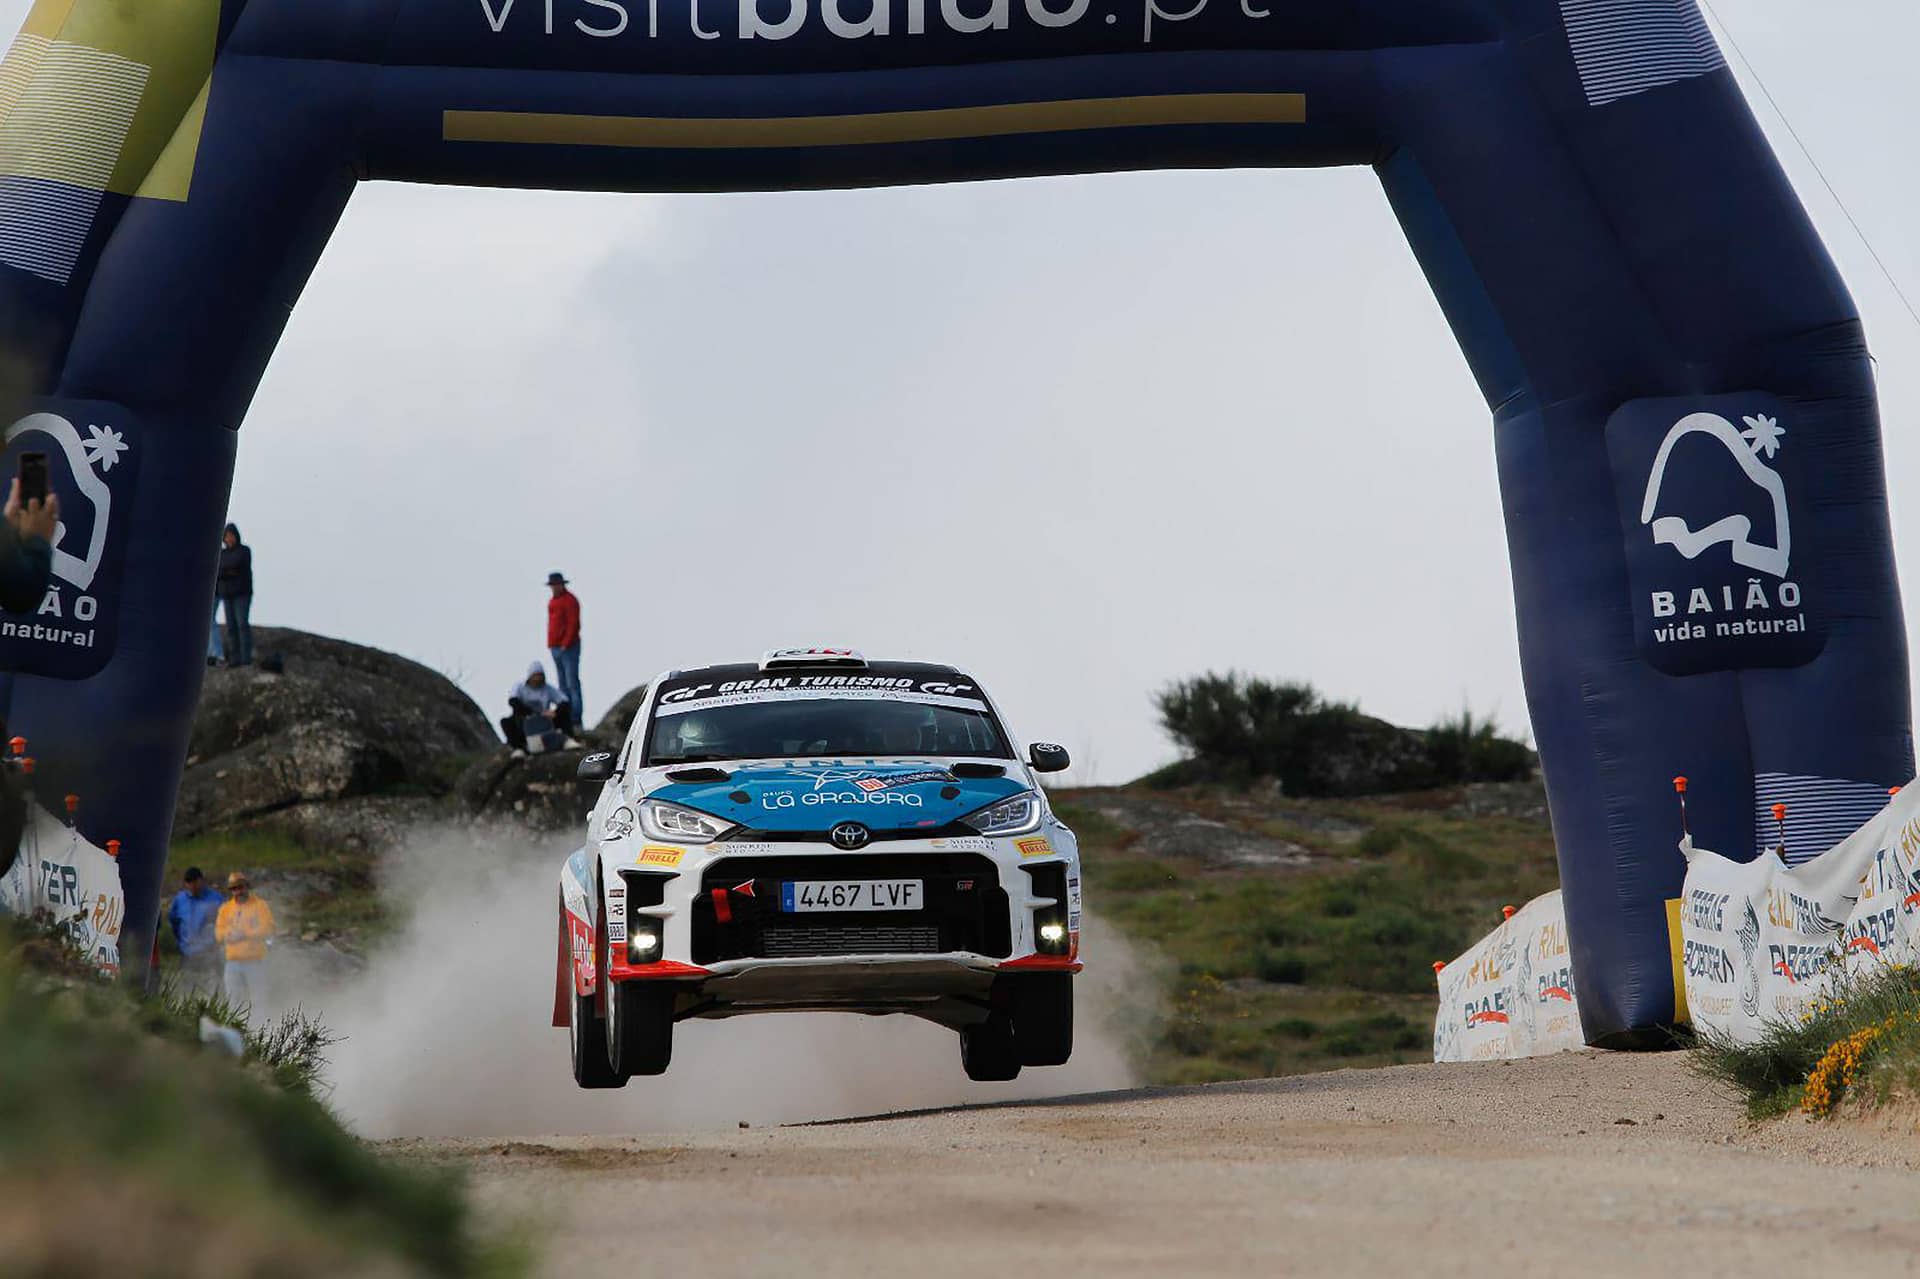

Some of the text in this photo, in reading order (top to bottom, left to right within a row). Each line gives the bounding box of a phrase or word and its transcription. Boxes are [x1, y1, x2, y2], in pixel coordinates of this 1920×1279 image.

[1651, 578, 1801, 617] BAIÃO
[2, 622, 95, 648] natural
[1654, 613, 1806, 643] vida natural
[718, 675, 914, 692] GRAN TURISMO
[800, 884, 916, 907] 4467 LVF
